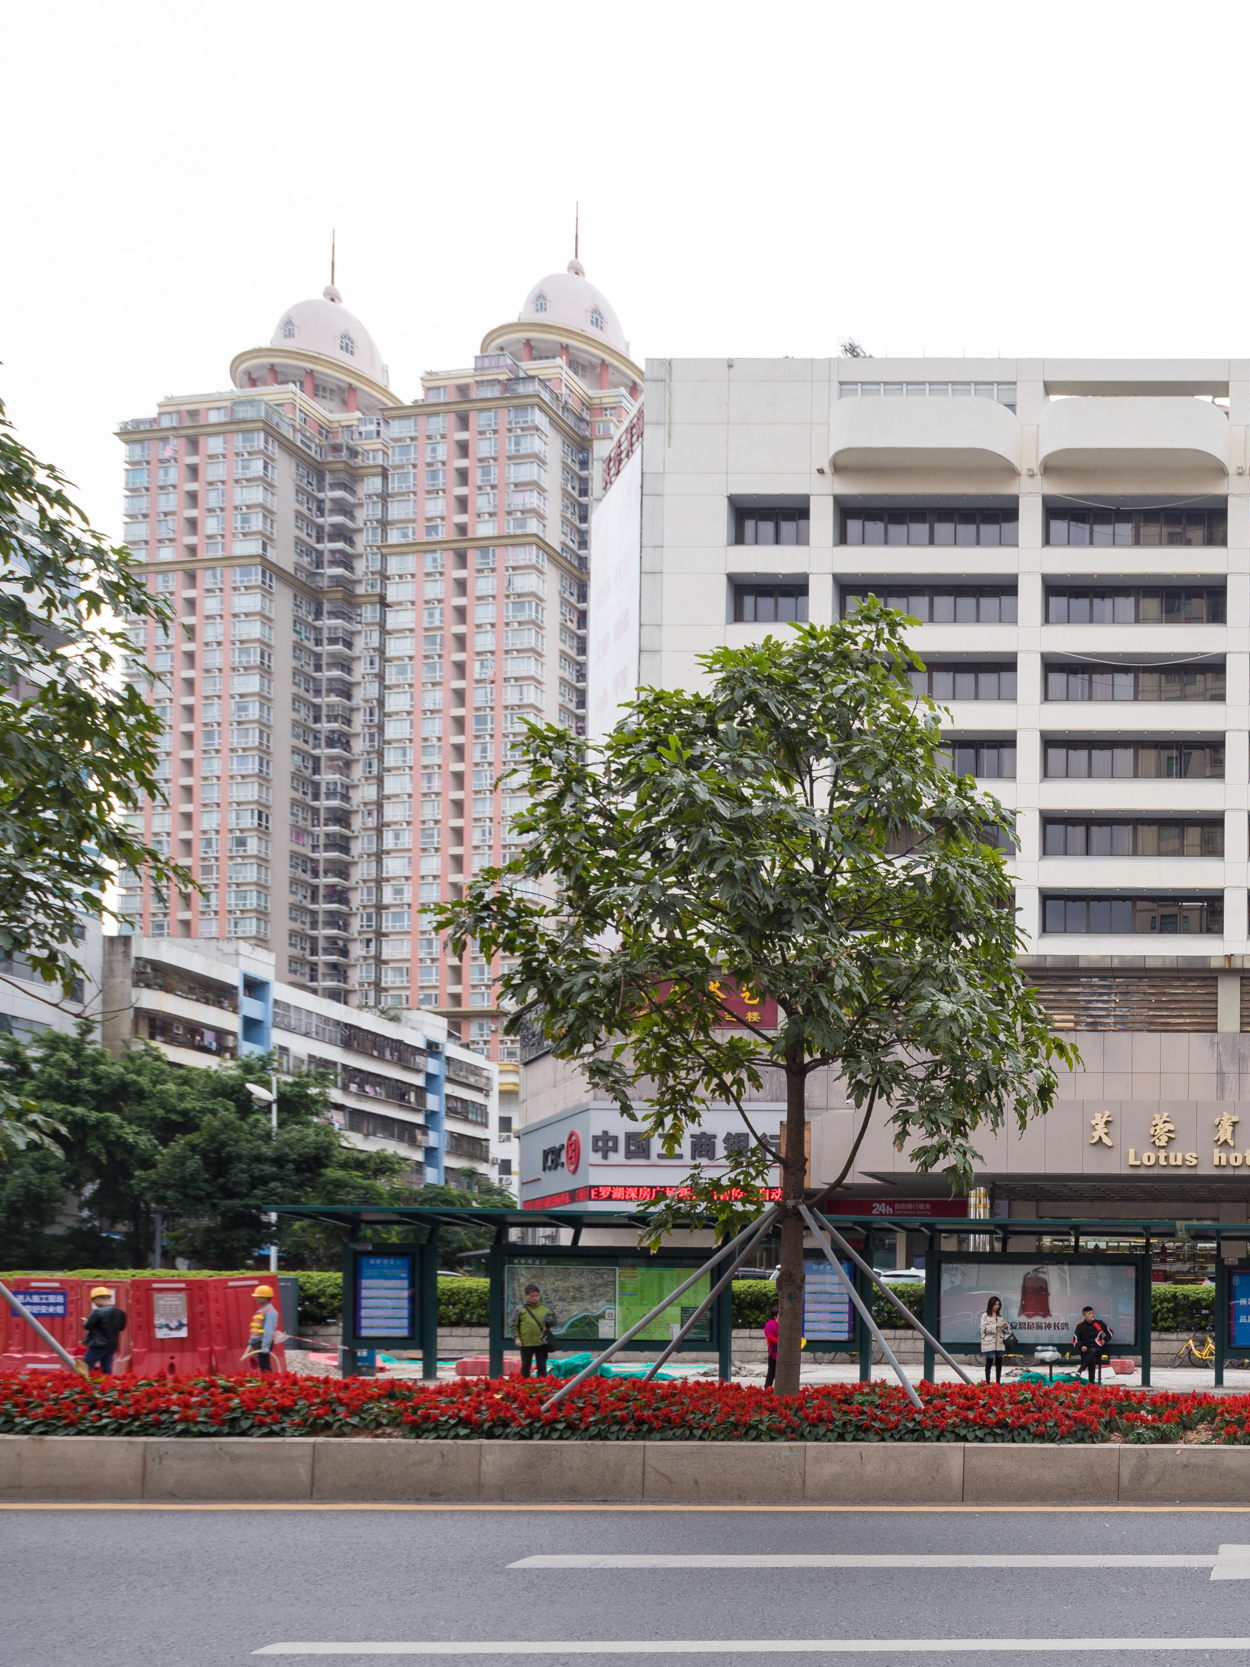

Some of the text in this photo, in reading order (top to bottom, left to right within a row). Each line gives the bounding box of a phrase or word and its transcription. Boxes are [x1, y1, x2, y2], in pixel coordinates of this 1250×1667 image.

[542, 1143, 565, 1173] ICBC
[1128, 1148, 1198, 1167] Lotus
[872, 1202, 893, 1215] 24h
[1007, 1321, 1070, 1331] 安思危警钟长鸣
